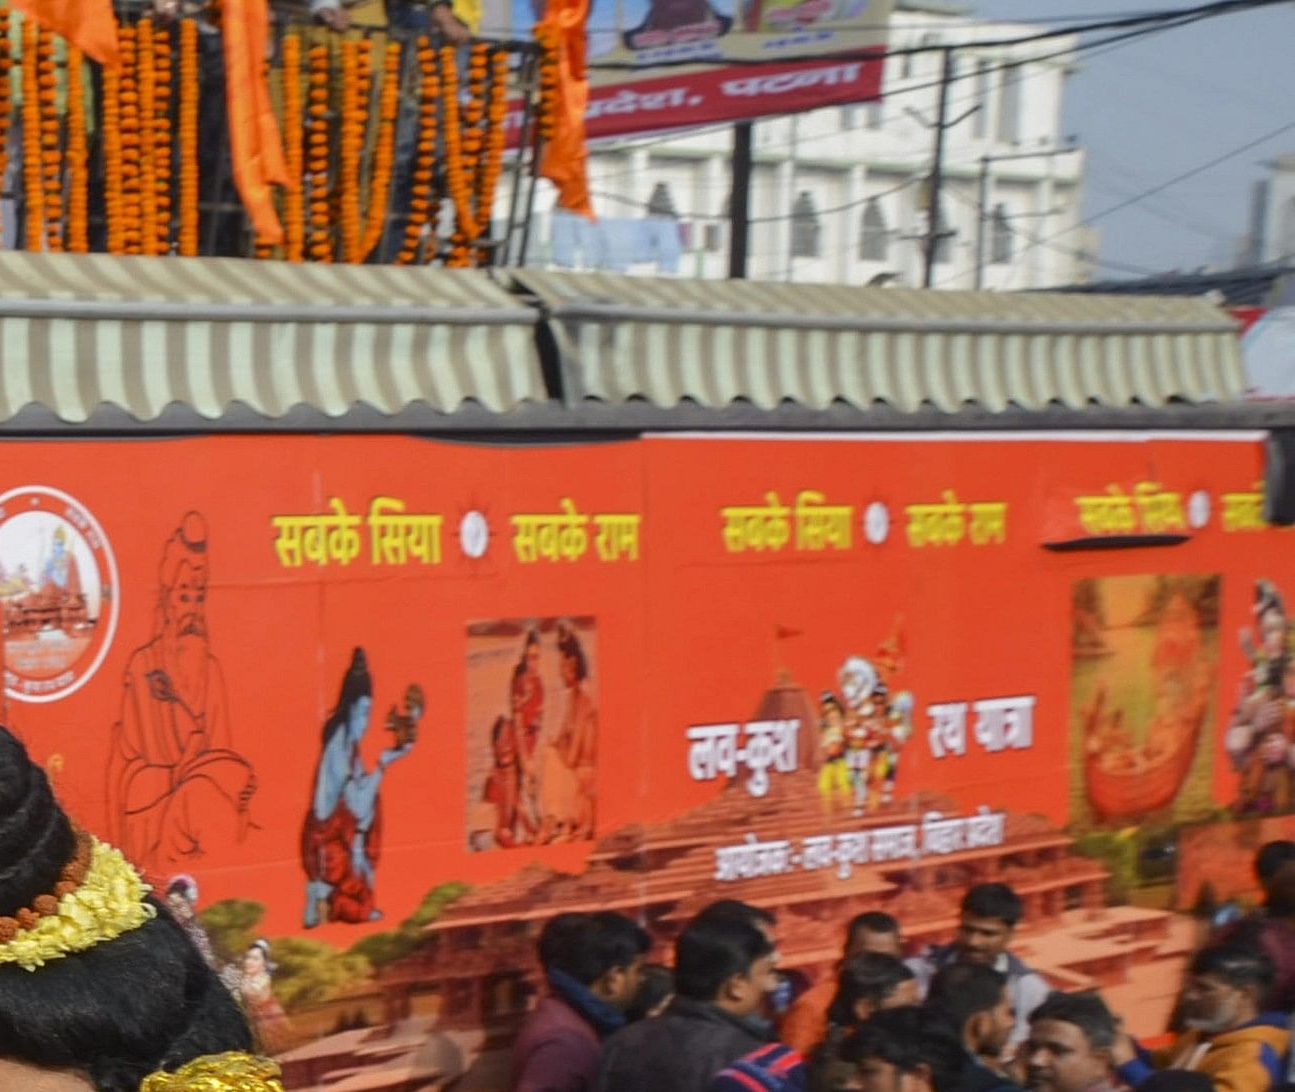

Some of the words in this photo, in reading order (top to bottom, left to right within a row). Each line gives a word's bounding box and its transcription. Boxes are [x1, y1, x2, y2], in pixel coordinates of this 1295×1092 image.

[720, 63, 861, 97] पटना
[272, 496, 361, 567] सबके
[367, 496, 443, 565] सिया
[512, 497, 588, 562] सबके
[593, 513, 642, 561] राम
[721, 491, 790, 552] सबके
[795, 490, 853, 550] सिया
[905, 489, 964, 547] सबके
[968, 502, 1007, 545] राम
[686, 719, 801, 797] लव-कुश
[926, 702, 968, 759] रथ
[972, 694, 1036, 752] यात्रा
